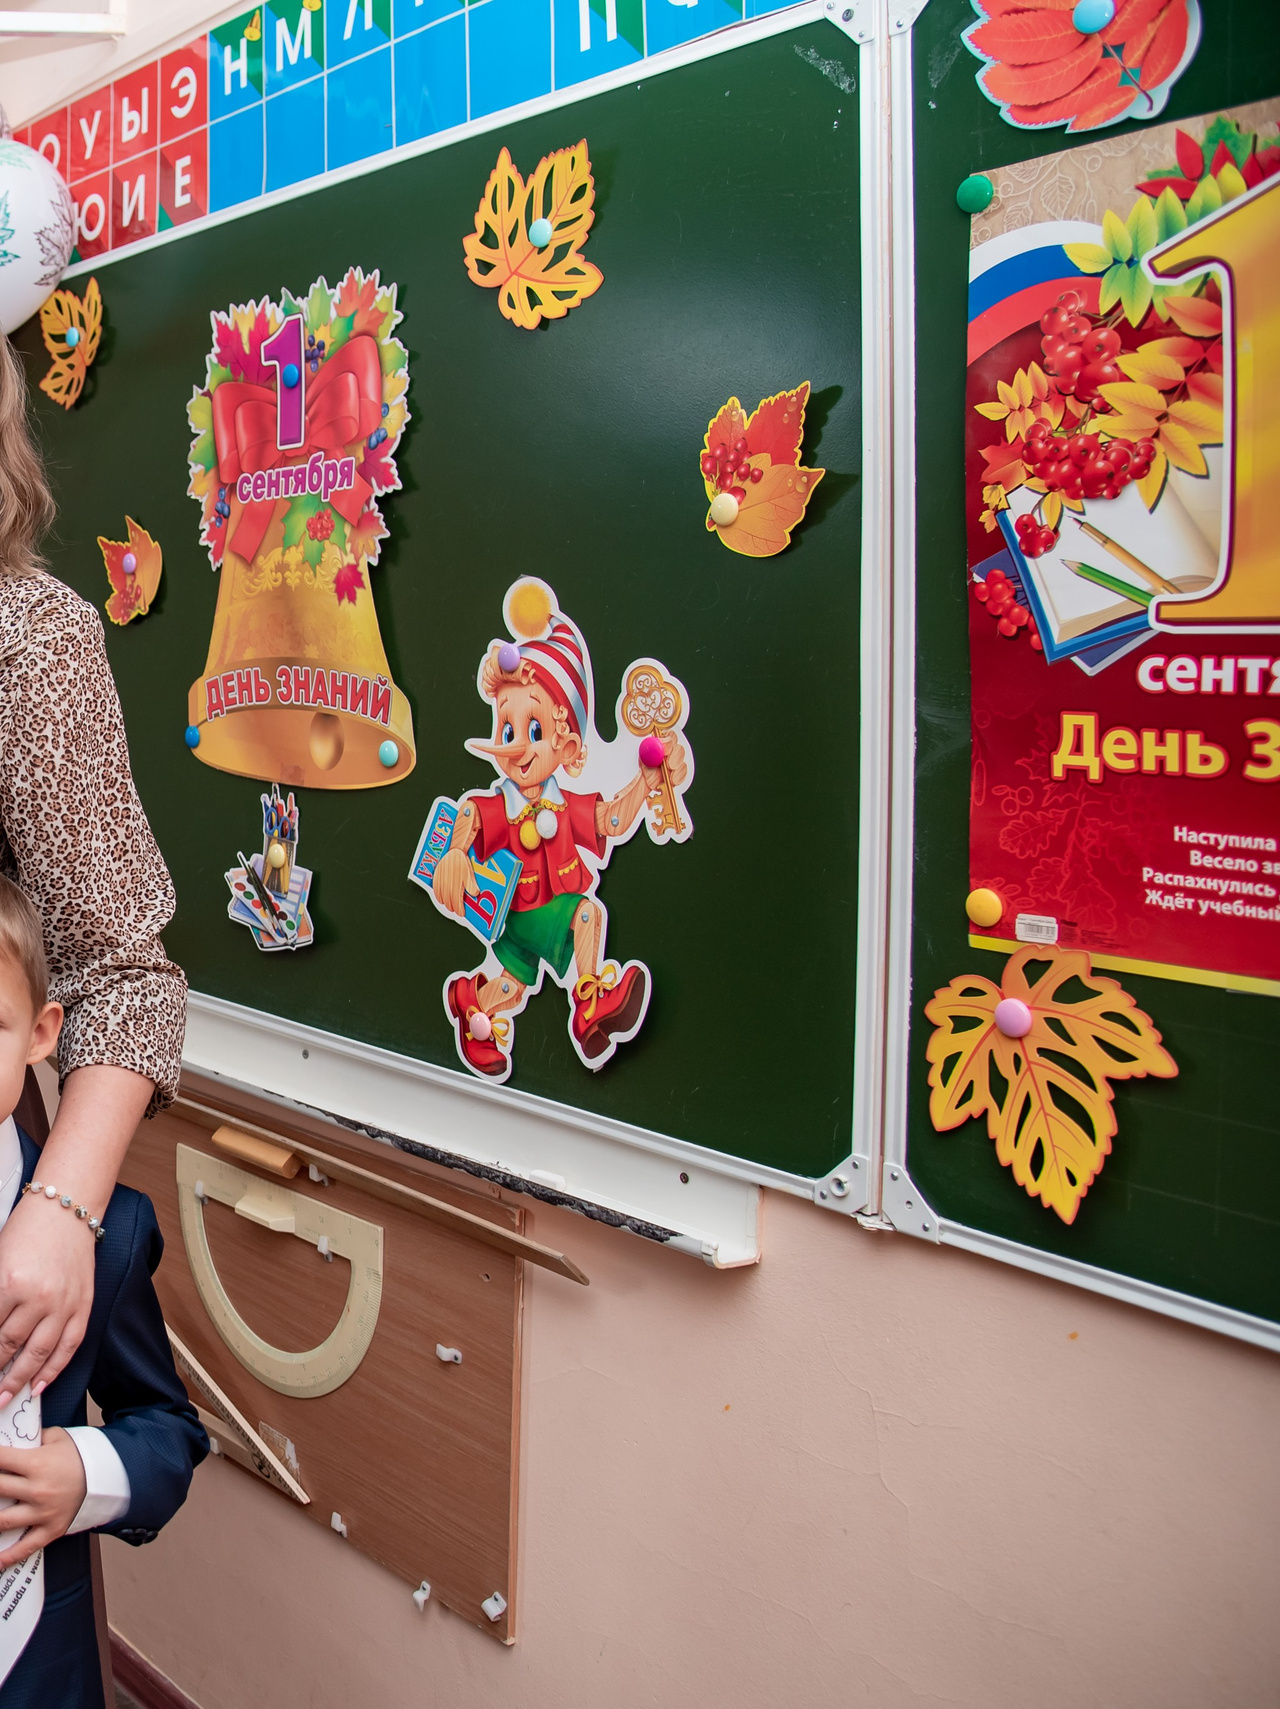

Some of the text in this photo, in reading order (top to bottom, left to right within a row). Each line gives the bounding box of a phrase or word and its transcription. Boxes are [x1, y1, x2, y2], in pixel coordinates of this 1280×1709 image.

[79, 109, 102, 160] У
[122, 86, 148, 143] Ы
[170, 66, 197, 118] Э
[224, 37, 247, 96] Н
[276, 8, 312, 72] М
[73, 155, 192, 247] Ю И Е
[261, 312, 305, 450] 1
[237, 451, 355, 504] сентября
[205, 665, 392, 727] ДЕНЬ ЗНАНИЙ
[1051, 712, 1227, 782] День
[417, 808, 454, 879] АЗБУКА
[1173, 826, 1277, 852] Наступила
[1189, 850, 1259, 873] Весело
[1142, 867, 1277, 898] Распахнулись
[1144, 888, 1195, 911] Ждёт
[2, 1586, 27, 1621] прятки
[24, 1576, 32, 1585] в
